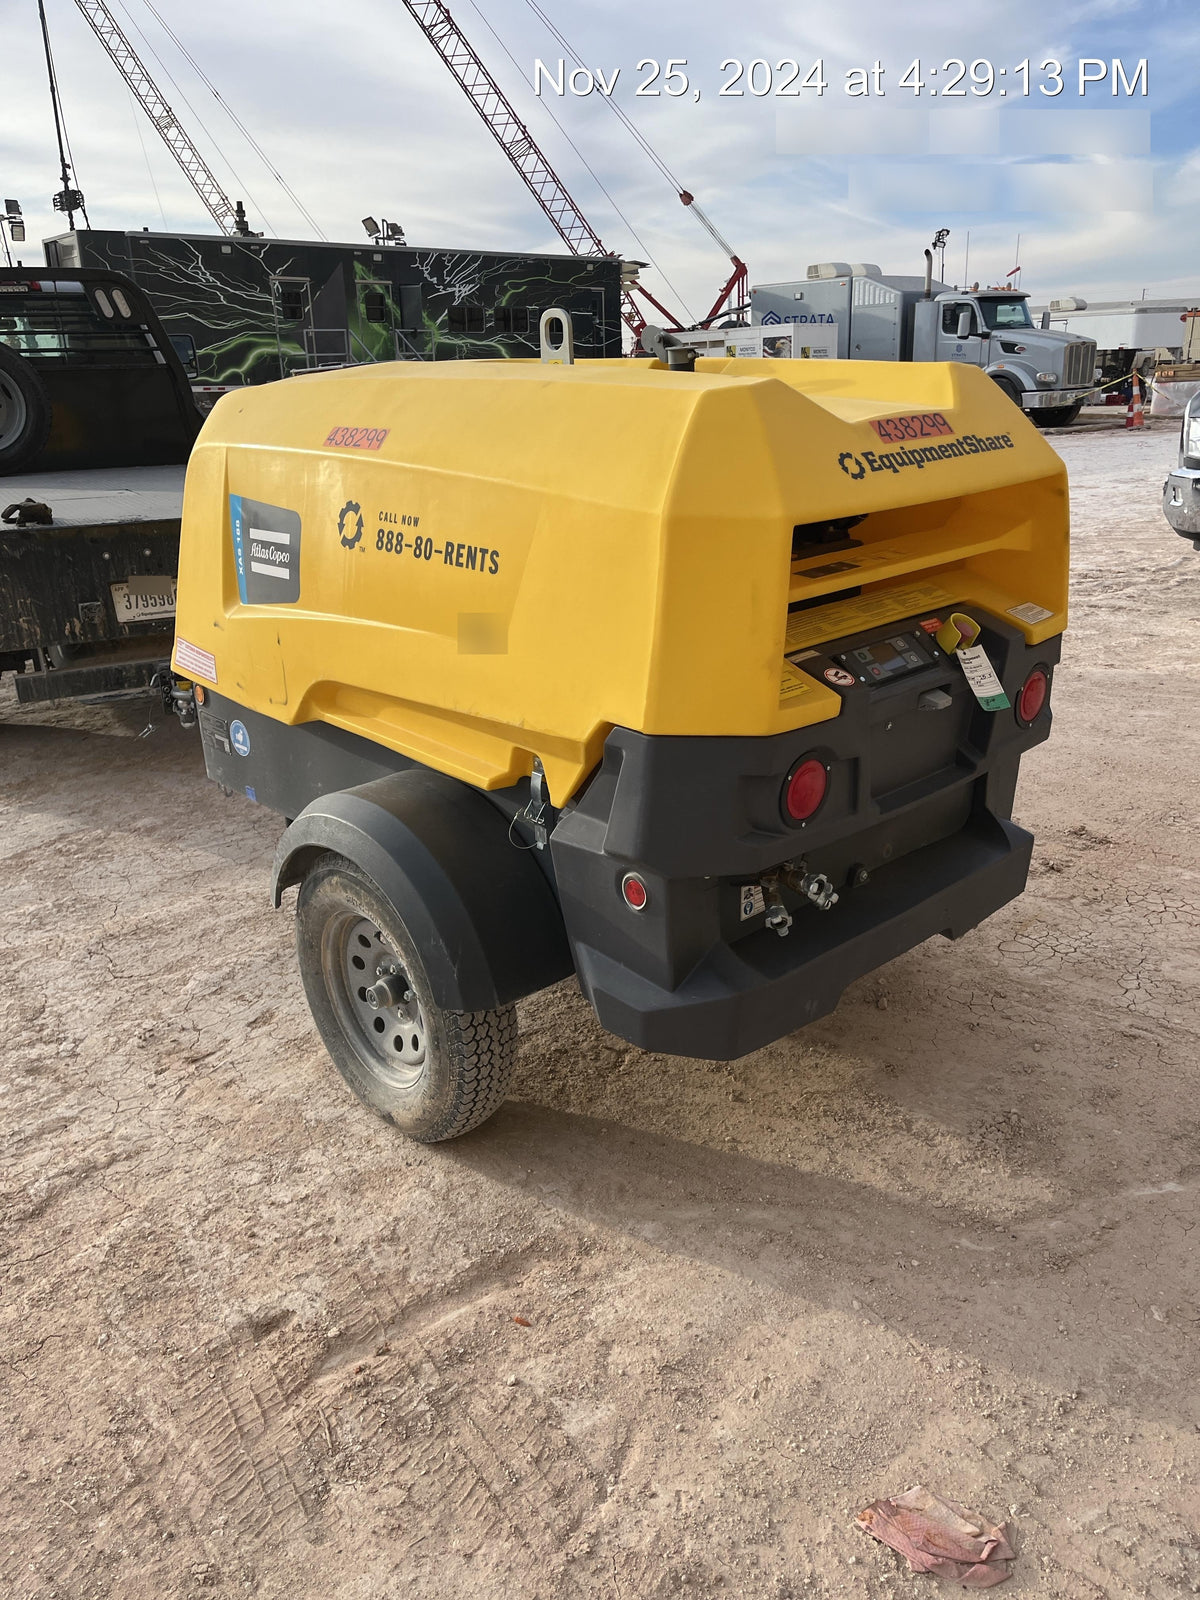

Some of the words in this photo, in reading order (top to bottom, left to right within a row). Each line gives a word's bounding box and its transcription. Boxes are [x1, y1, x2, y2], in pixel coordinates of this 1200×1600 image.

[326, 427, 388, 449] 438299
[876, 412, 954, 442] 438299
[861, 434, 1014, 474] EquipmentShare
[378, 511, 398, 524] CALL
[401, 514, 420, 527] NOW
[250, 542, 269, 561] Atlas
[269, 545, 290, 565] Copco
[376, 528, 500, 575] 888-80-RENTS
